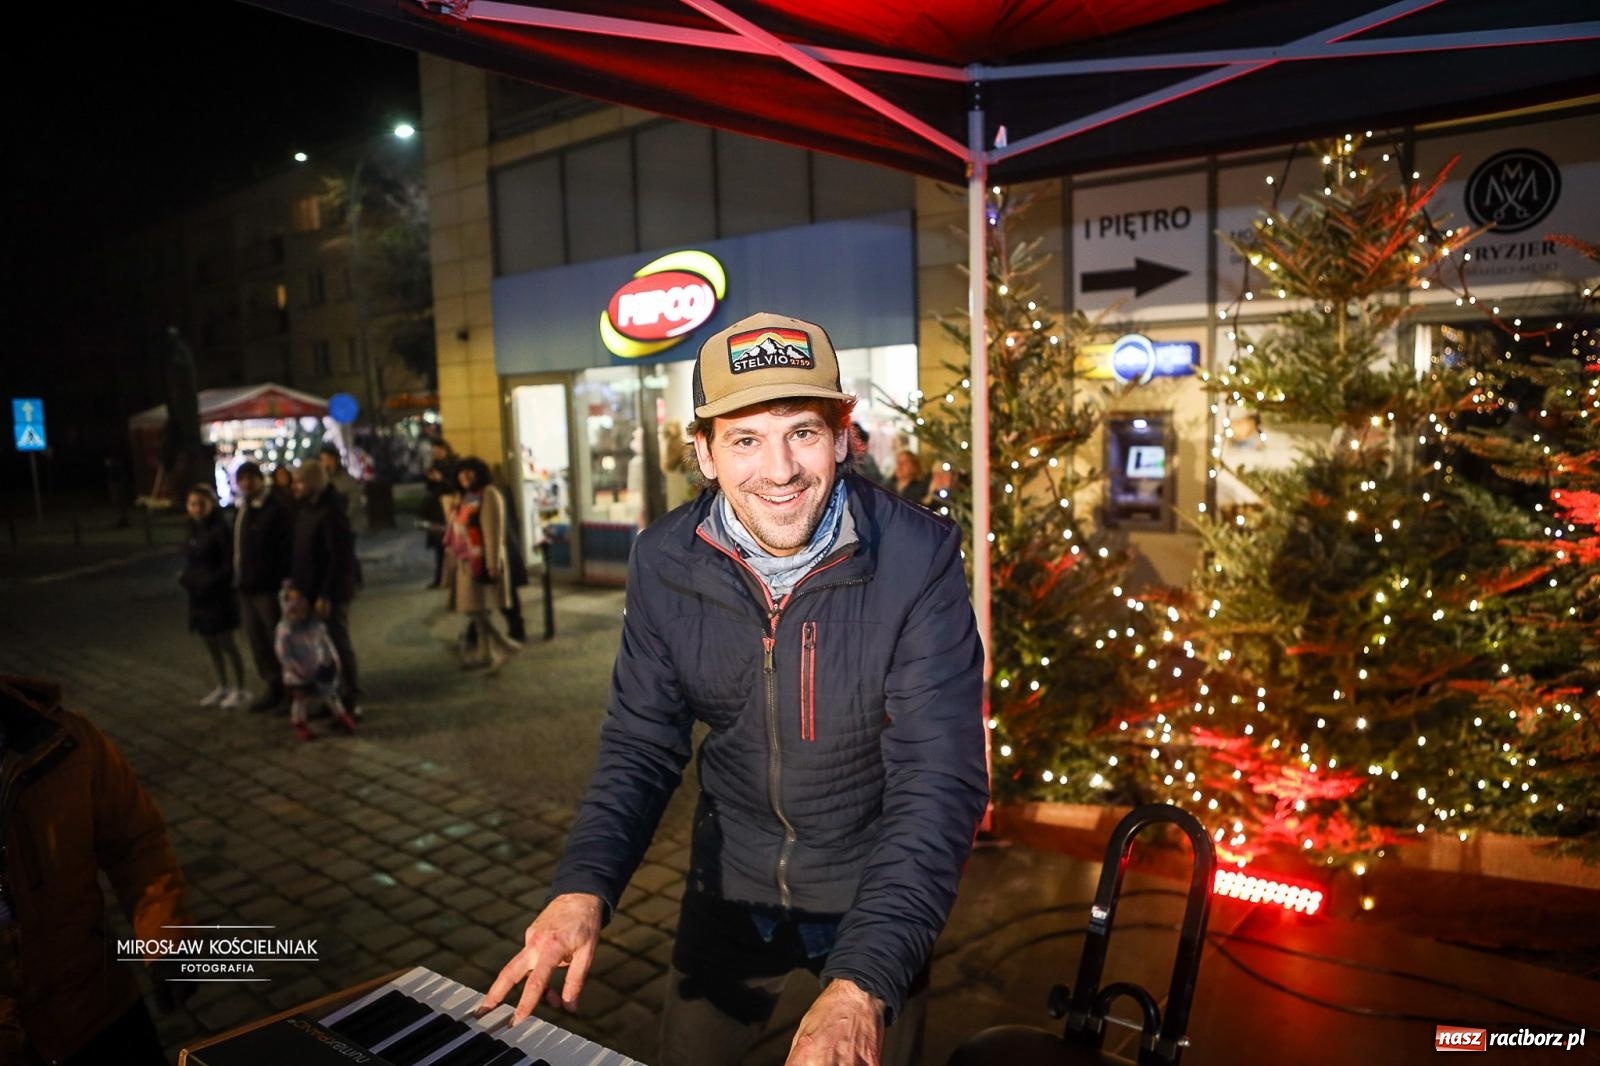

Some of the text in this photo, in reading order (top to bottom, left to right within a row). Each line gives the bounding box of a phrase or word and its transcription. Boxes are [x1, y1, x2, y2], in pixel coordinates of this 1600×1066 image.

[1084, 205, 1192, 241] I PIĘTRO
[733, 355, 788, 371] STELVIO
